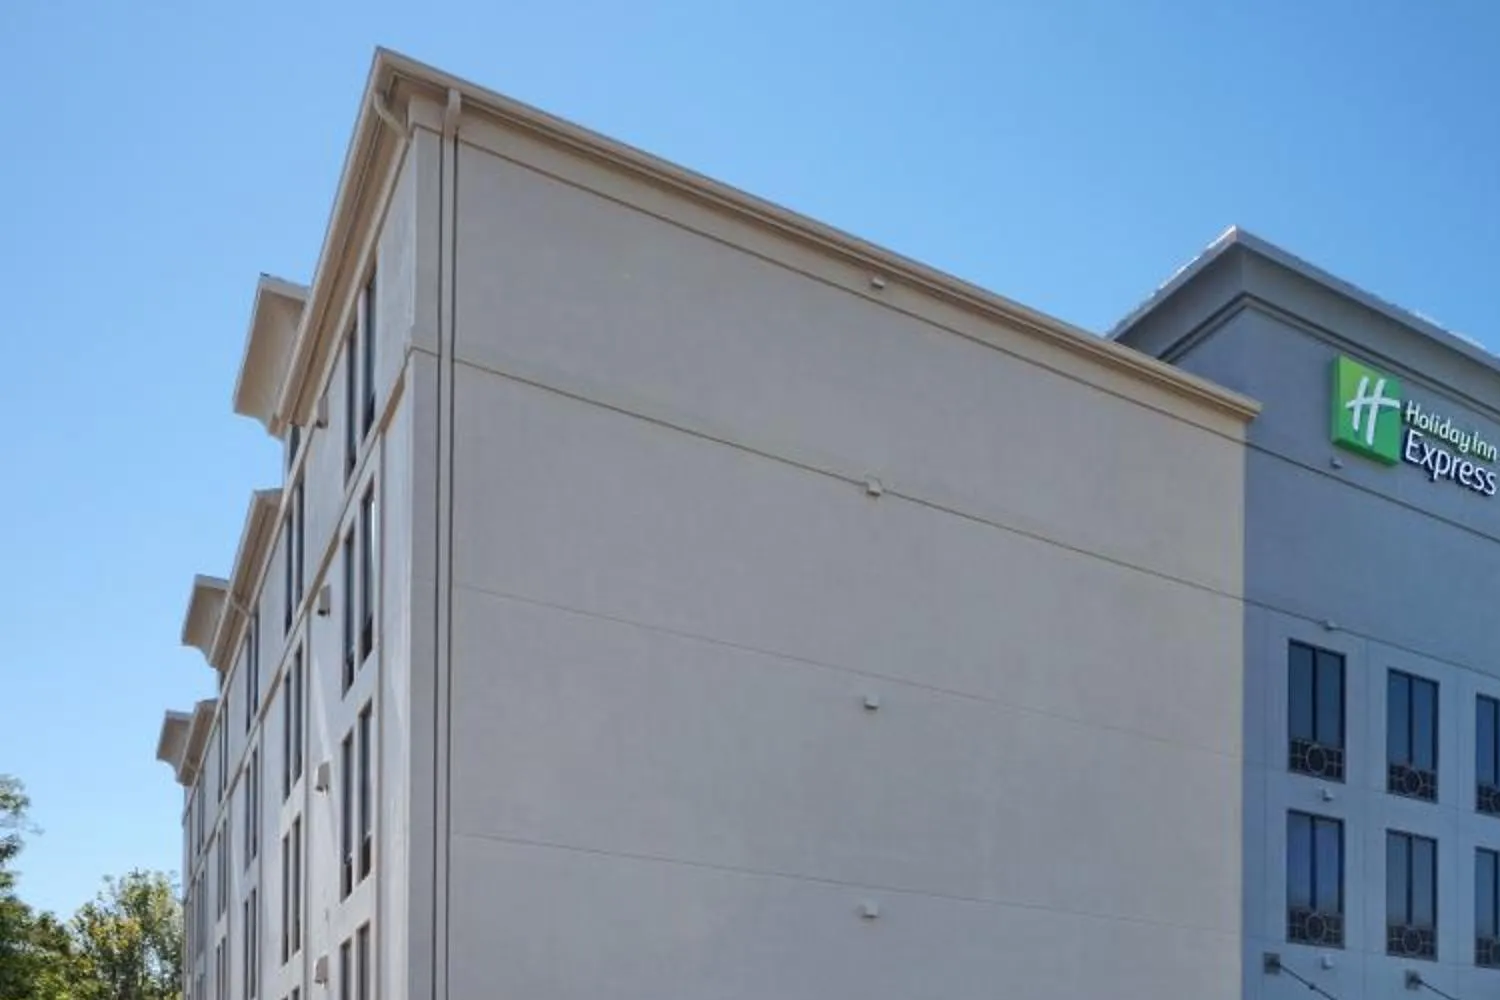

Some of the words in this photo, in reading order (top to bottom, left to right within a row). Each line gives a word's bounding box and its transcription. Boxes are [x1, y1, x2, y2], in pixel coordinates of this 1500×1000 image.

[1405, 399, 1471, 454] Holiday
[1472, 431, 1498, 461] Inn
[1405, 429, 1498, 496] Express
